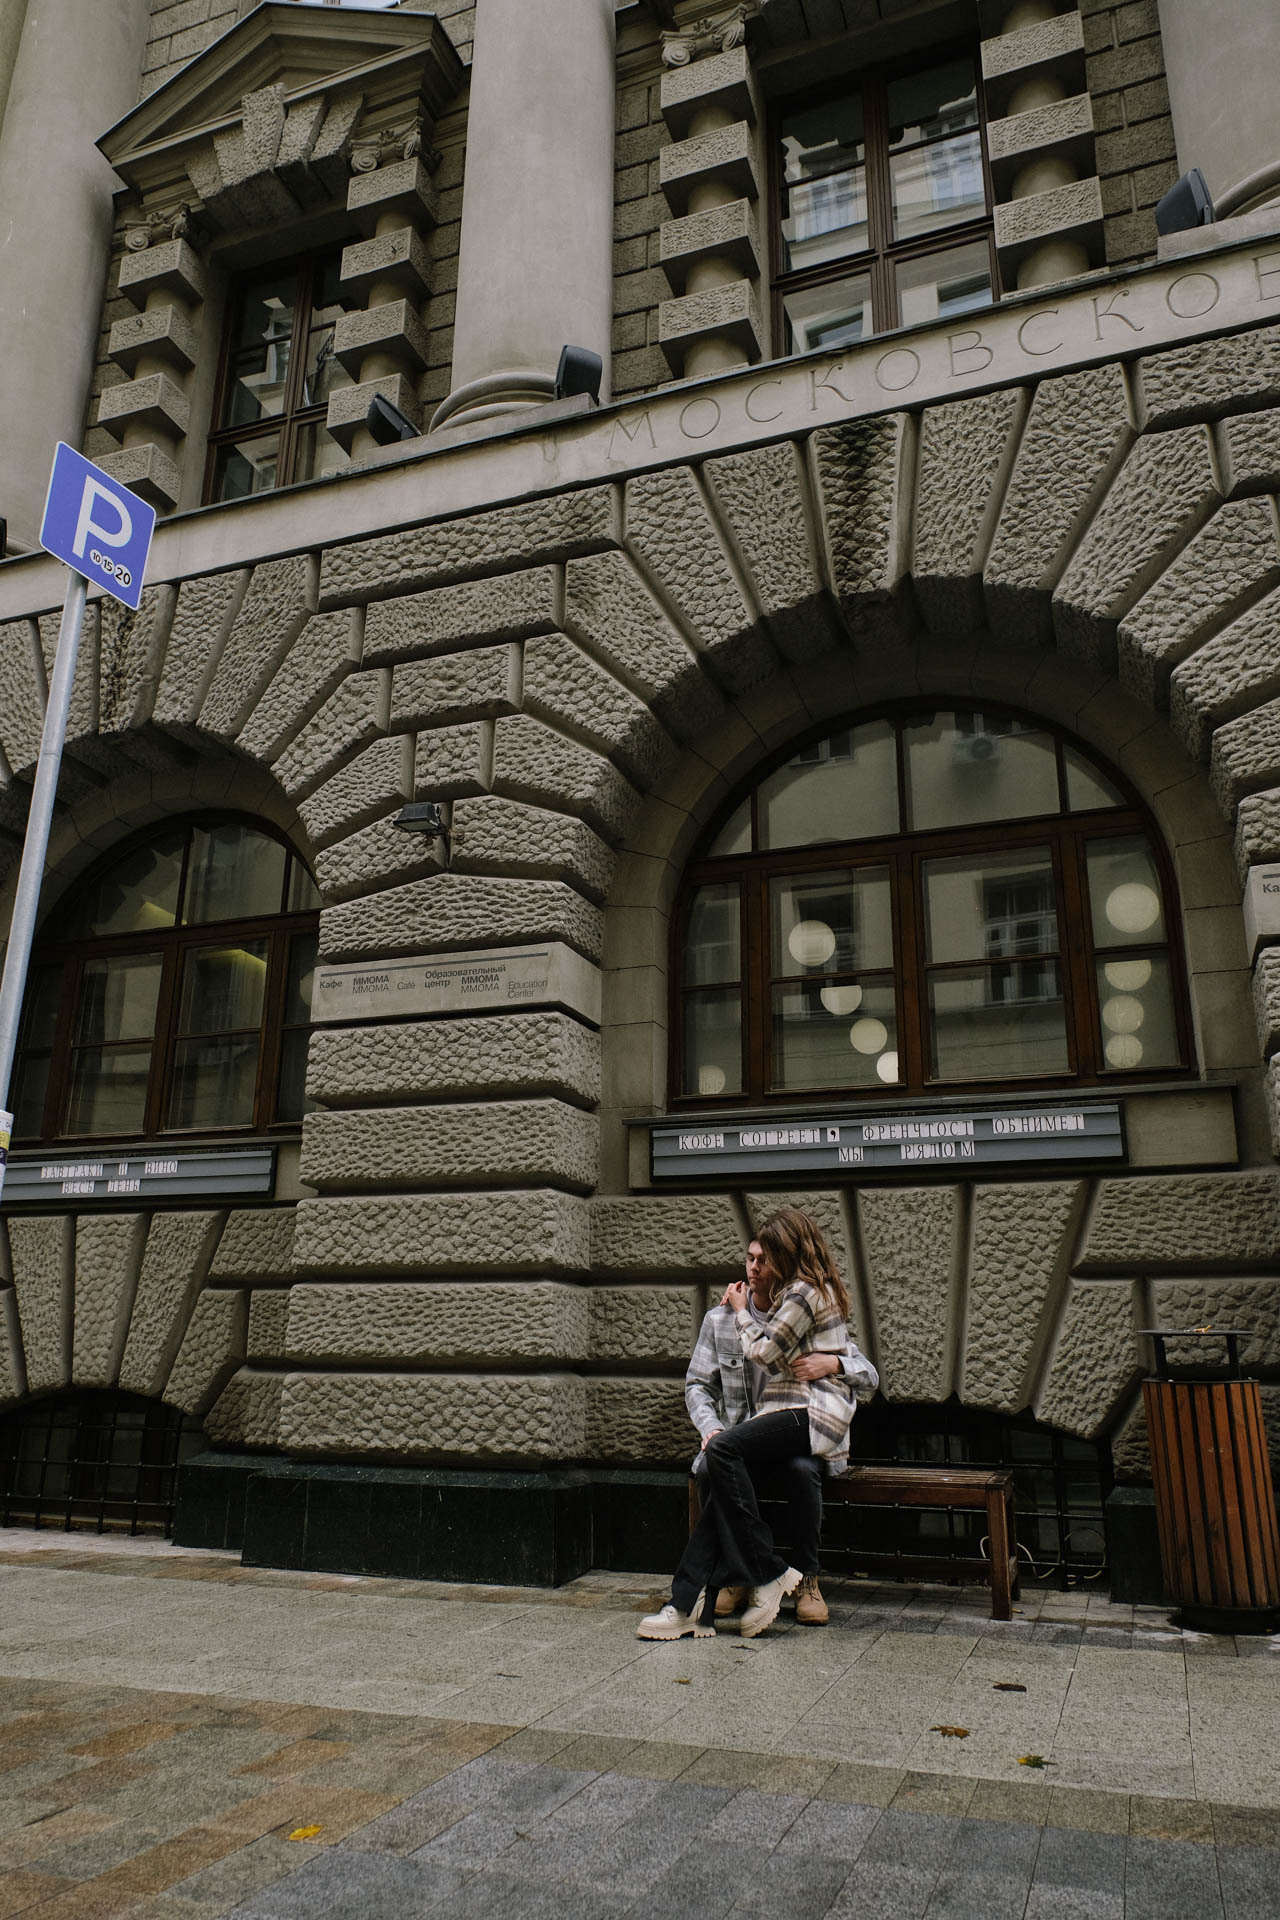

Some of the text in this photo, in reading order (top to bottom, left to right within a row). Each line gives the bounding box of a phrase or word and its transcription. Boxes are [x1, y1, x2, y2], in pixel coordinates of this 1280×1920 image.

[72, 474, 132, 559] P
[92, 552, 131, 585] 10 15 20
[424, 965, 506, 980] Образовательный
[319, 980, 343, 990] Кафе
[397, 981, 416, 991] Café
[424, 979, 451, 989] центр
[508, 979, 548, 990] Education
[507, 990, 535, 999] Center
[681, 1134, 722, 1149] КОФЕ
[864, 1120, 971, 1140] ФРЕНЧТОСТ
[994, 1114, 1082, 1134] ОБНИМЕТ
[840, 1147, 863, 1162] МЫ
[146, 1161, 178, 1174] ВИНО
[62, 1180, 95, 1193] ВЕСЬ
